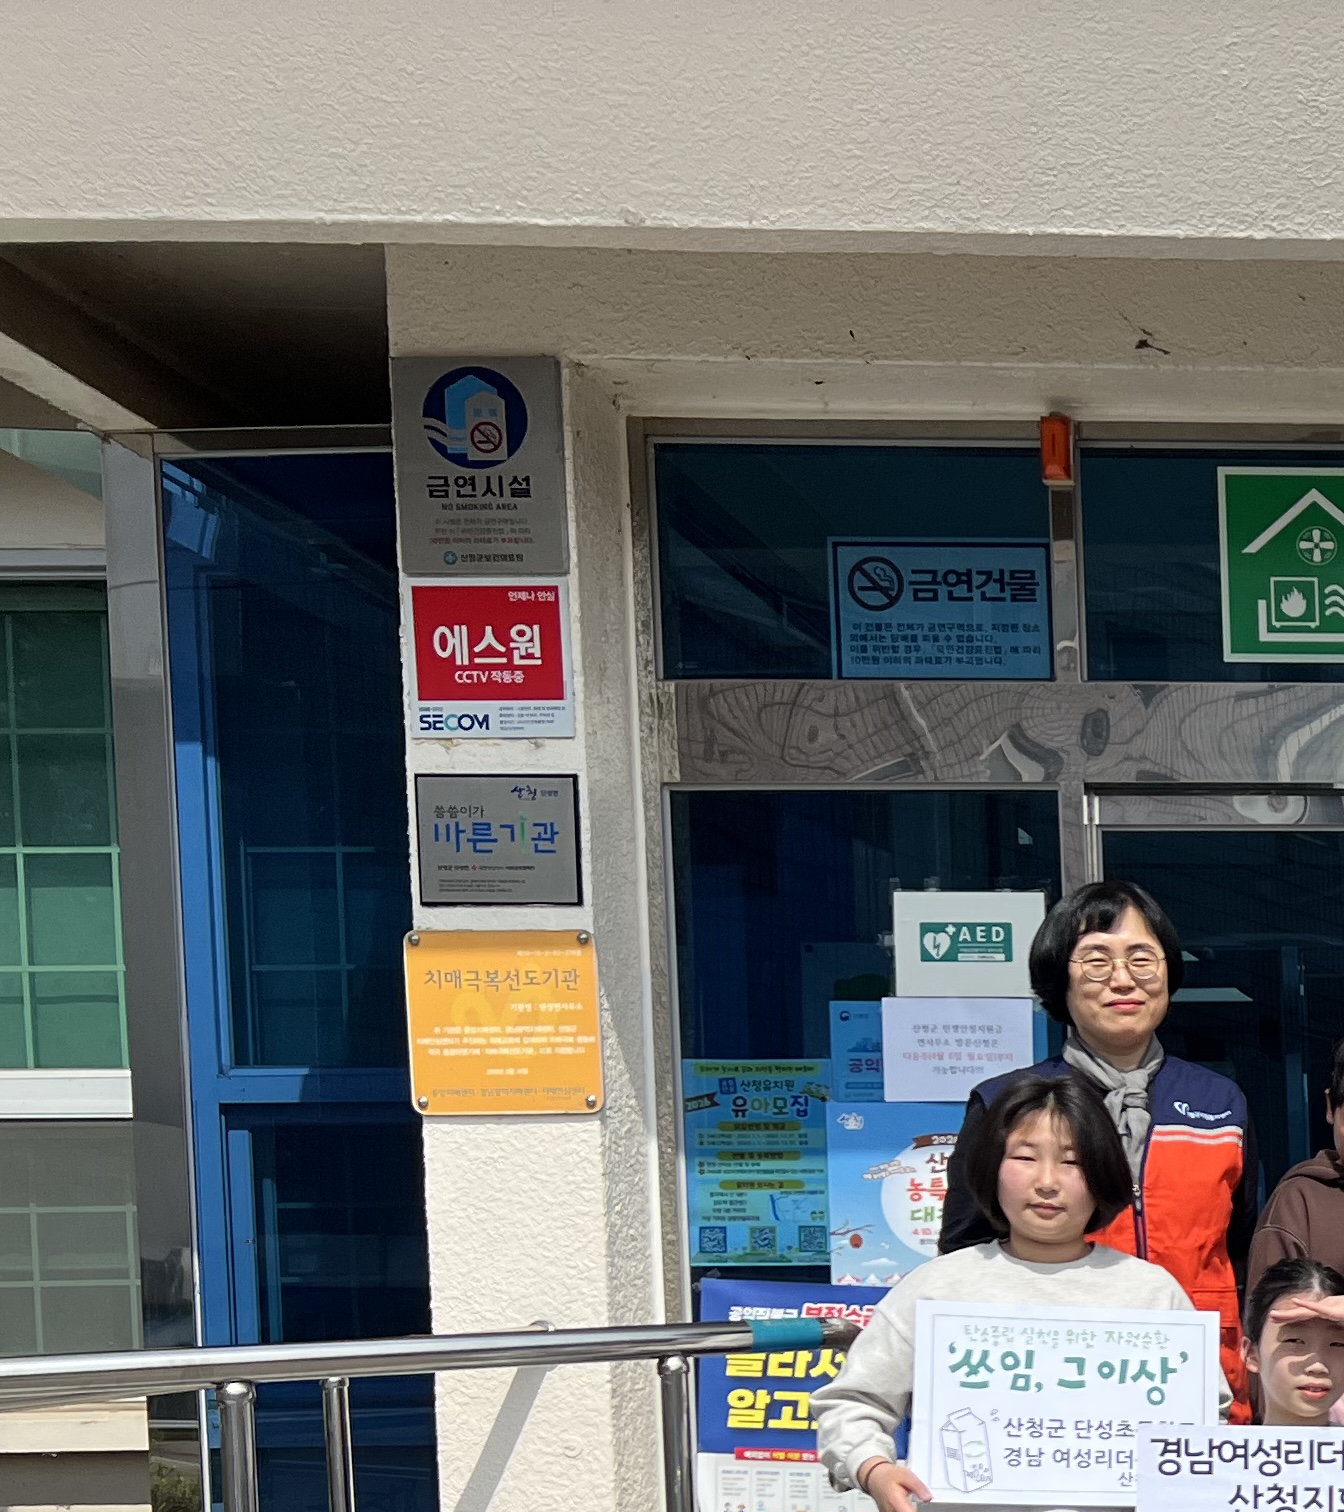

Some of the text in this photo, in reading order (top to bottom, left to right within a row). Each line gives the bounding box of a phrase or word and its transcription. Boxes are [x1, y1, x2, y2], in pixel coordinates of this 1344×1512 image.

[426, 475, 532, 499] 금연시설
[456, 502, 493, 510] SMOKING
[909, 568, 1040, 602] 금연건물
[508, 591, 535, 601] 언제나
[433, 624, 542, 665] 에스원
[455, 671, 524, 683] CCTV 작동중
[419, 714, 490, 731] SECOM
[434, 805, 484, 819] 씀씀이가
[434, 817, 559, 853] 바른기관
[959, 926, 1005, 942] AED
[425, 968, 580, 992] 치매극복선도기관
[732, 1096, 809, 1118] 유아모집
[964, 1325, 1170, 1348] 탄소중립 실천을 위한 자원순환
[727, 1388, 819, 1429] 알고
[1004, 1418, 1194, 1439] 산청군 단성초
[1004, 1448, 1138, 1469] 경남 여성리더
